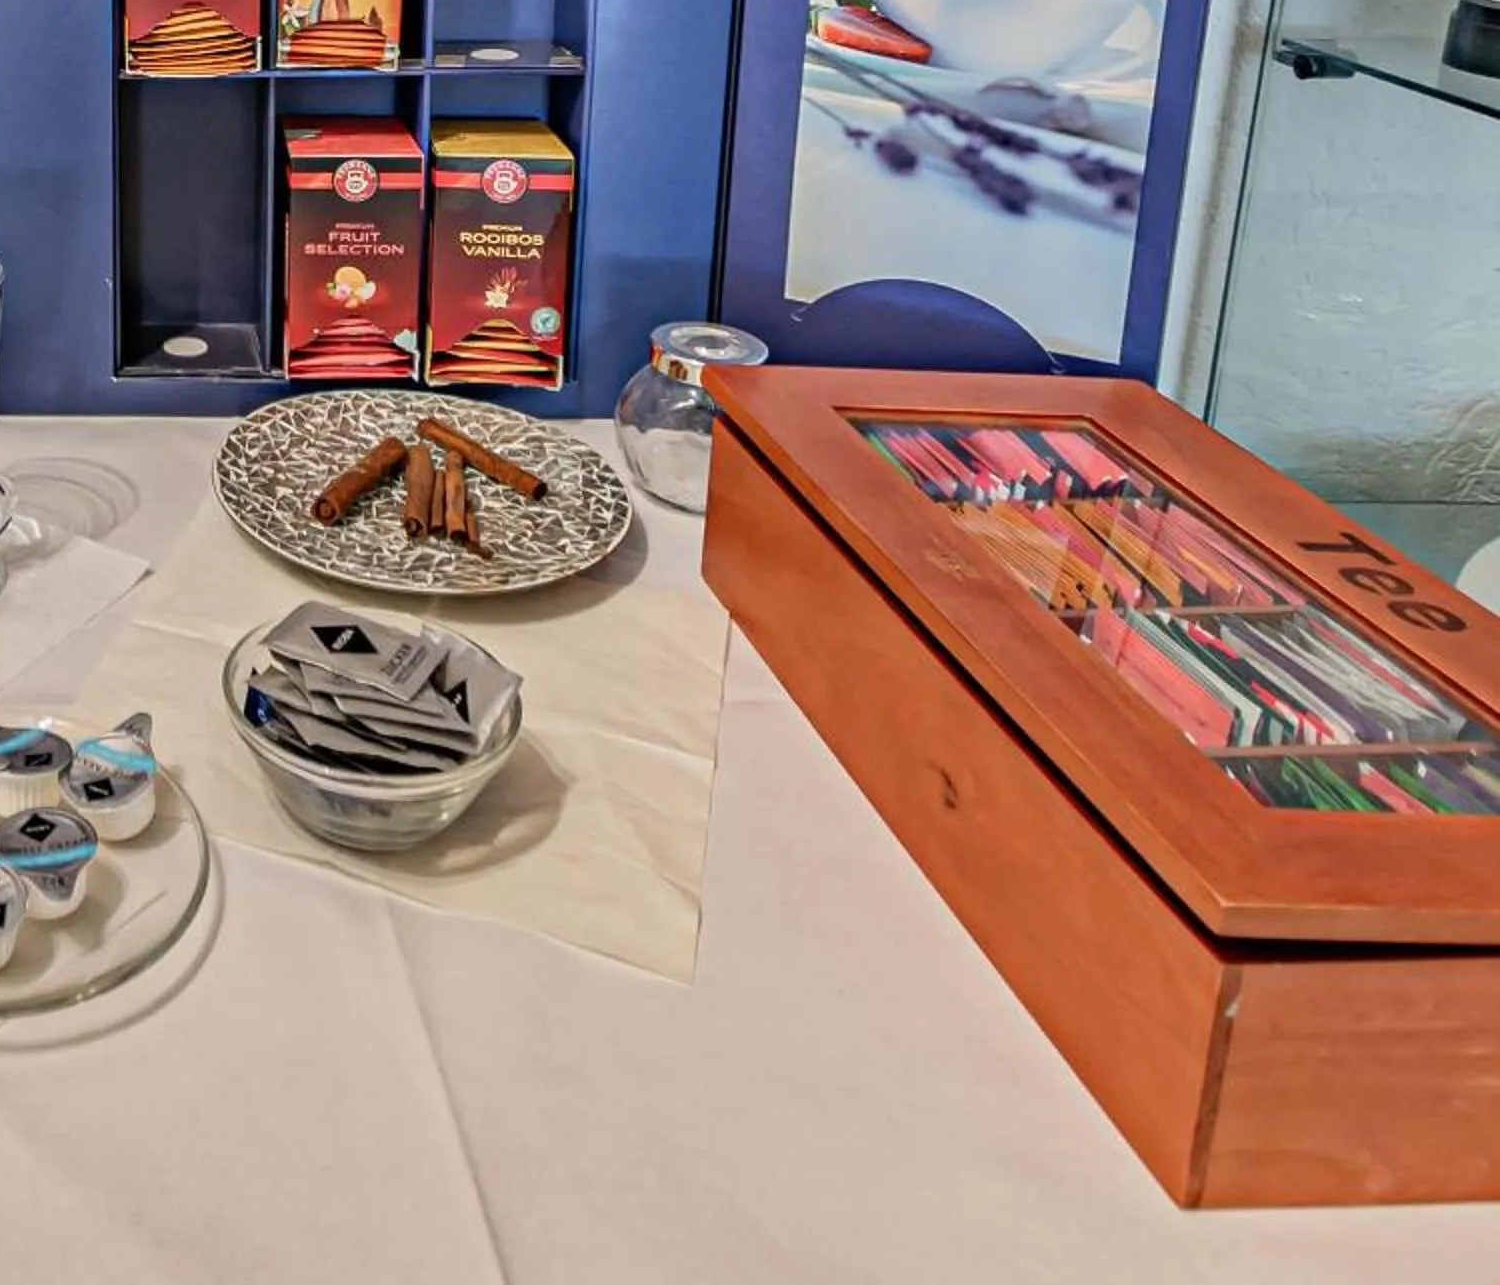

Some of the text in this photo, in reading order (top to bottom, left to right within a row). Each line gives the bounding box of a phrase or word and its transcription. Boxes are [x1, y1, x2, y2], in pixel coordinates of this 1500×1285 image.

[328, 231, 381, 243] FRUIT
[460, 232, 545, 247] ROOIBOS
[304, 243, 405, 256] SELECTION
[462, 245, 541, 259] VANILLA
[1295, 530, 1468, 633] Tee
